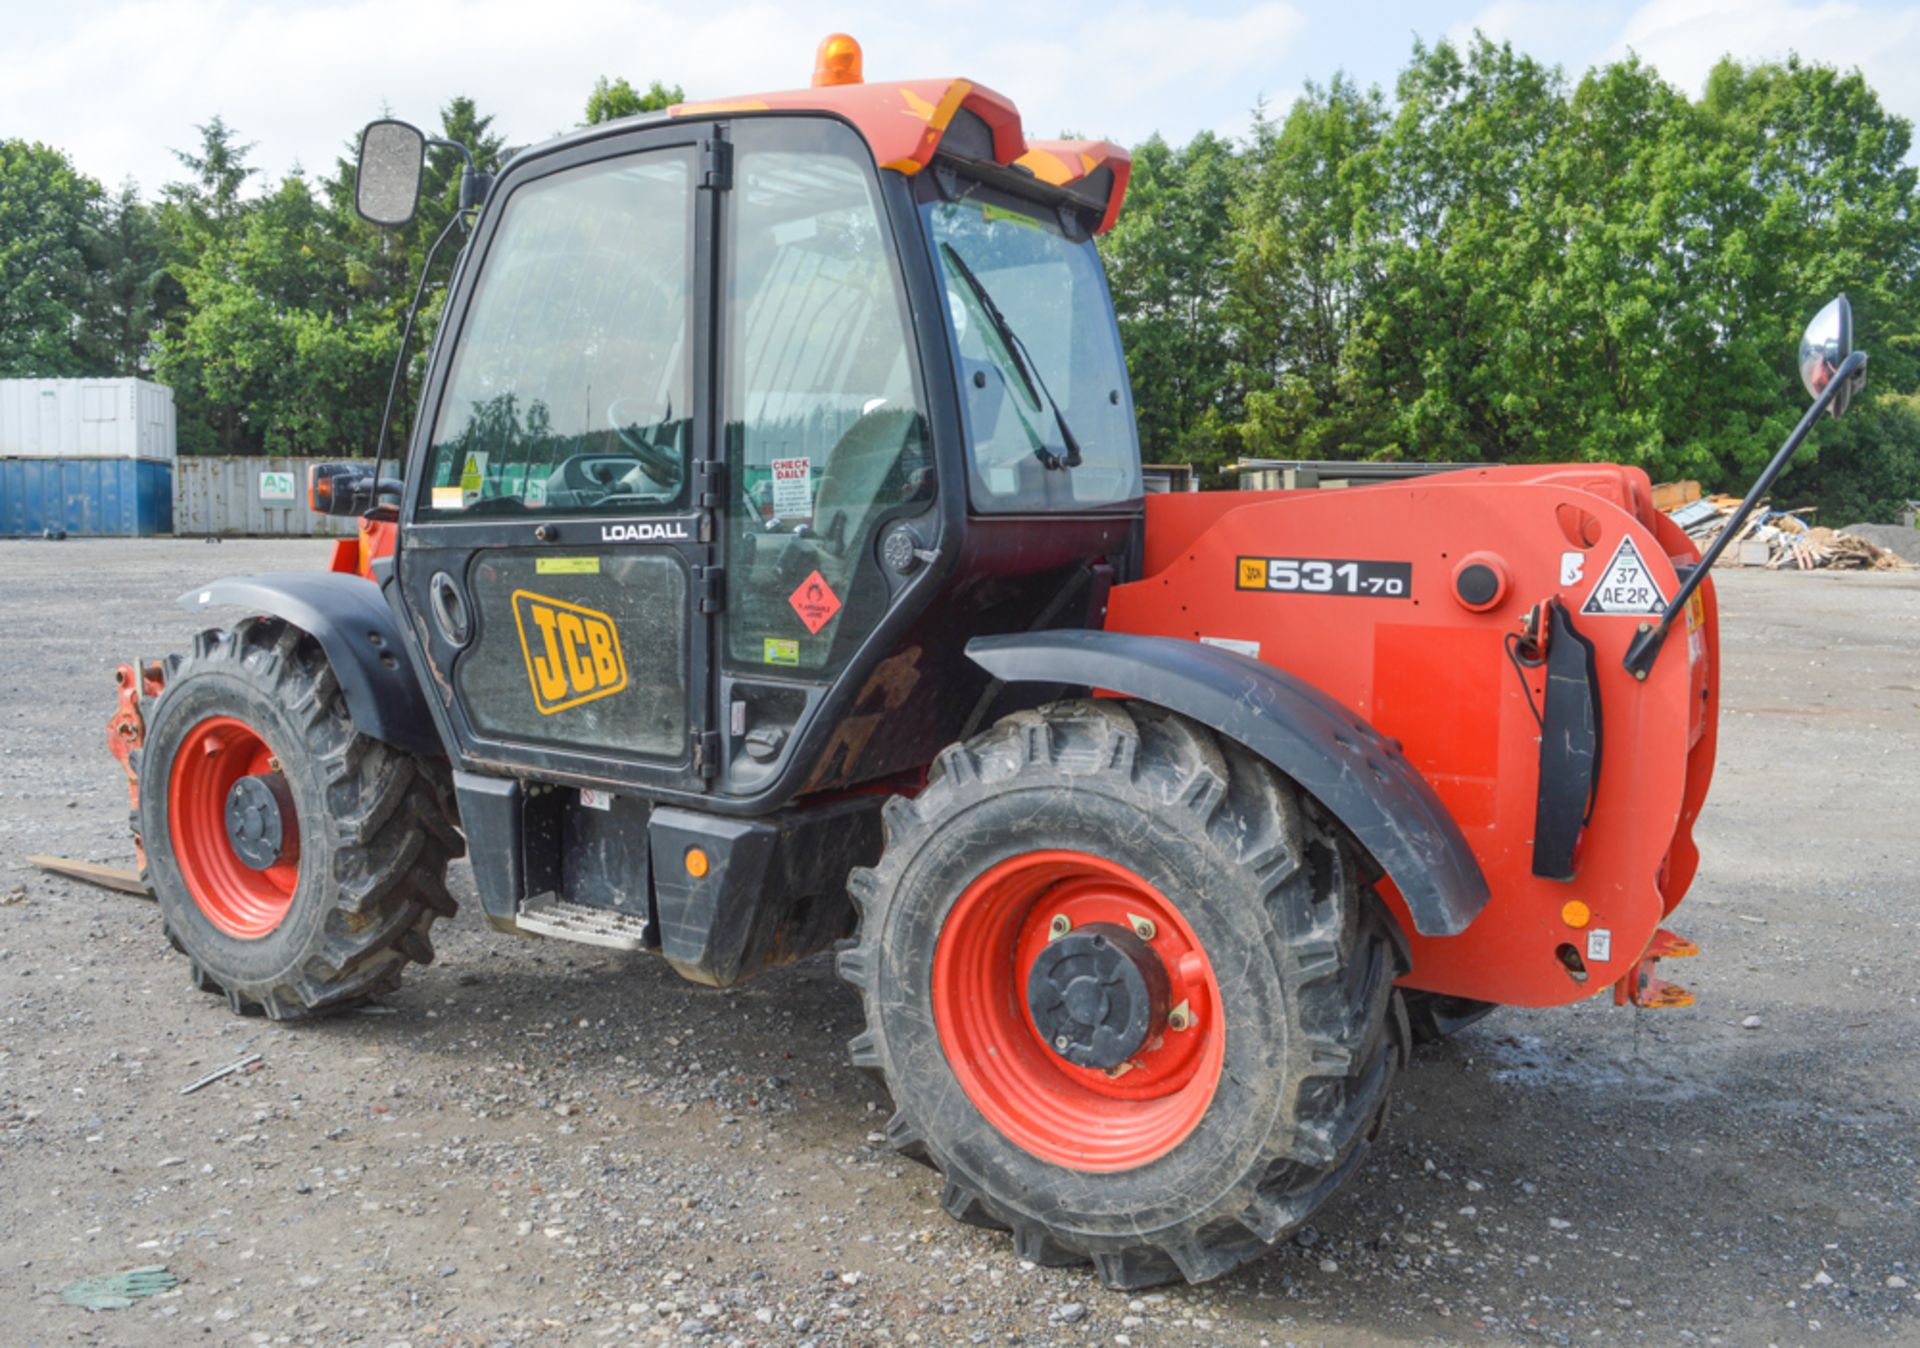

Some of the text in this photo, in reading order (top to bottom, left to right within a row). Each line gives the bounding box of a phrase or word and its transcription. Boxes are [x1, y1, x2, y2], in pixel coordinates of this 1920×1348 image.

[773, 459, 809, 471] CHECK
[776, 470, 806, 481] DAILY
[601, 523, 688, 541] LOADALL
[1615, 567, 1639, 585] 37
[1602, 587, 1649, 604] AE2R
[532, 604, 619, 702] JCB
